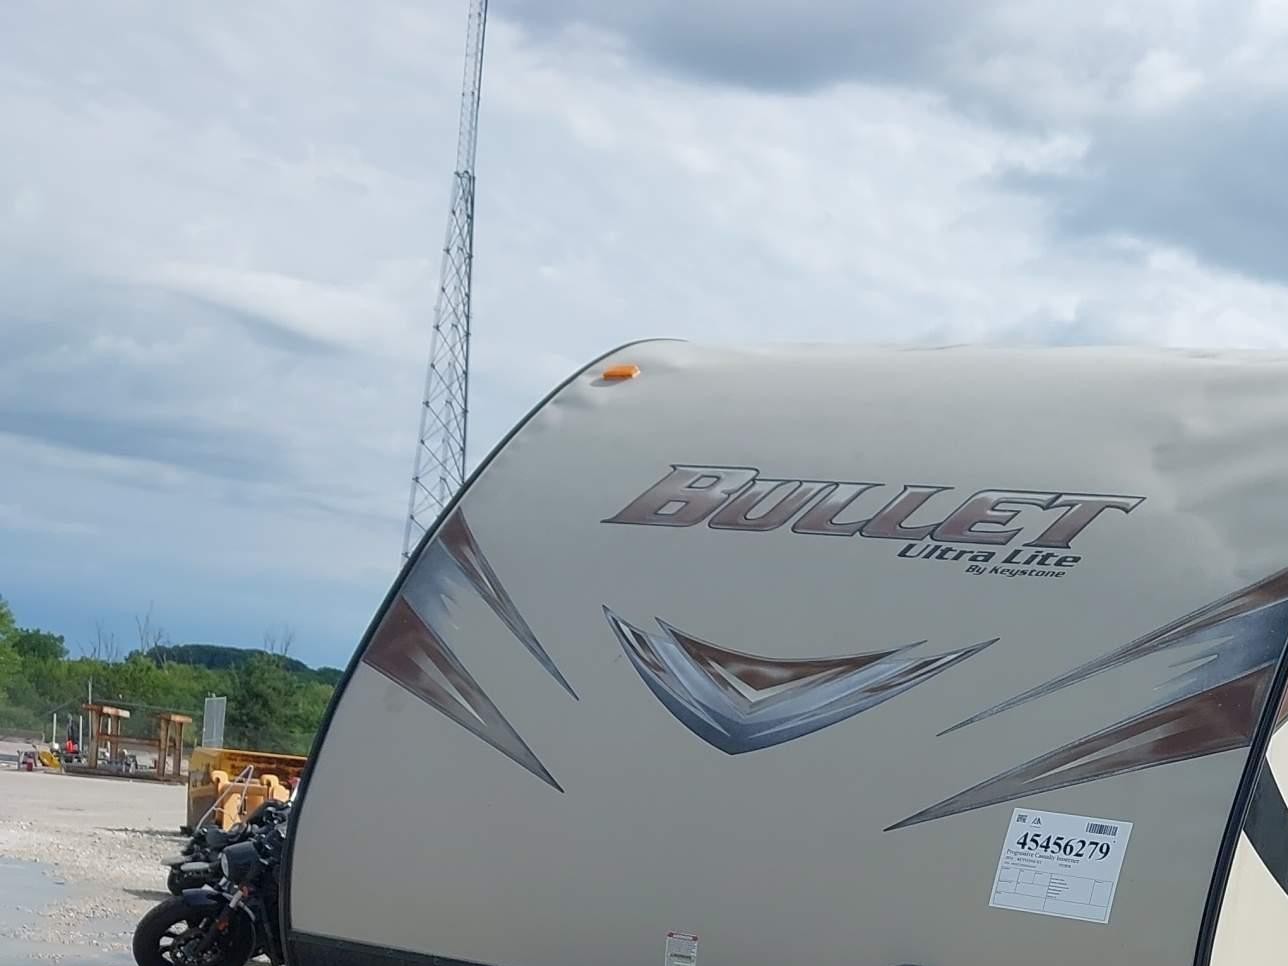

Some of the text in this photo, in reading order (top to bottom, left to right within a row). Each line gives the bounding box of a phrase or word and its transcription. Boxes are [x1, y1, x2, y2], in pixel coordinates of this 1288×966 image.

[600, 464, 1147, 549] BULLET
[897, 543, 1082, 568] Ultra Lite
[965, 564, 1066, 579] By Keystone
[1016, 831, 1111, 861] 45456279
